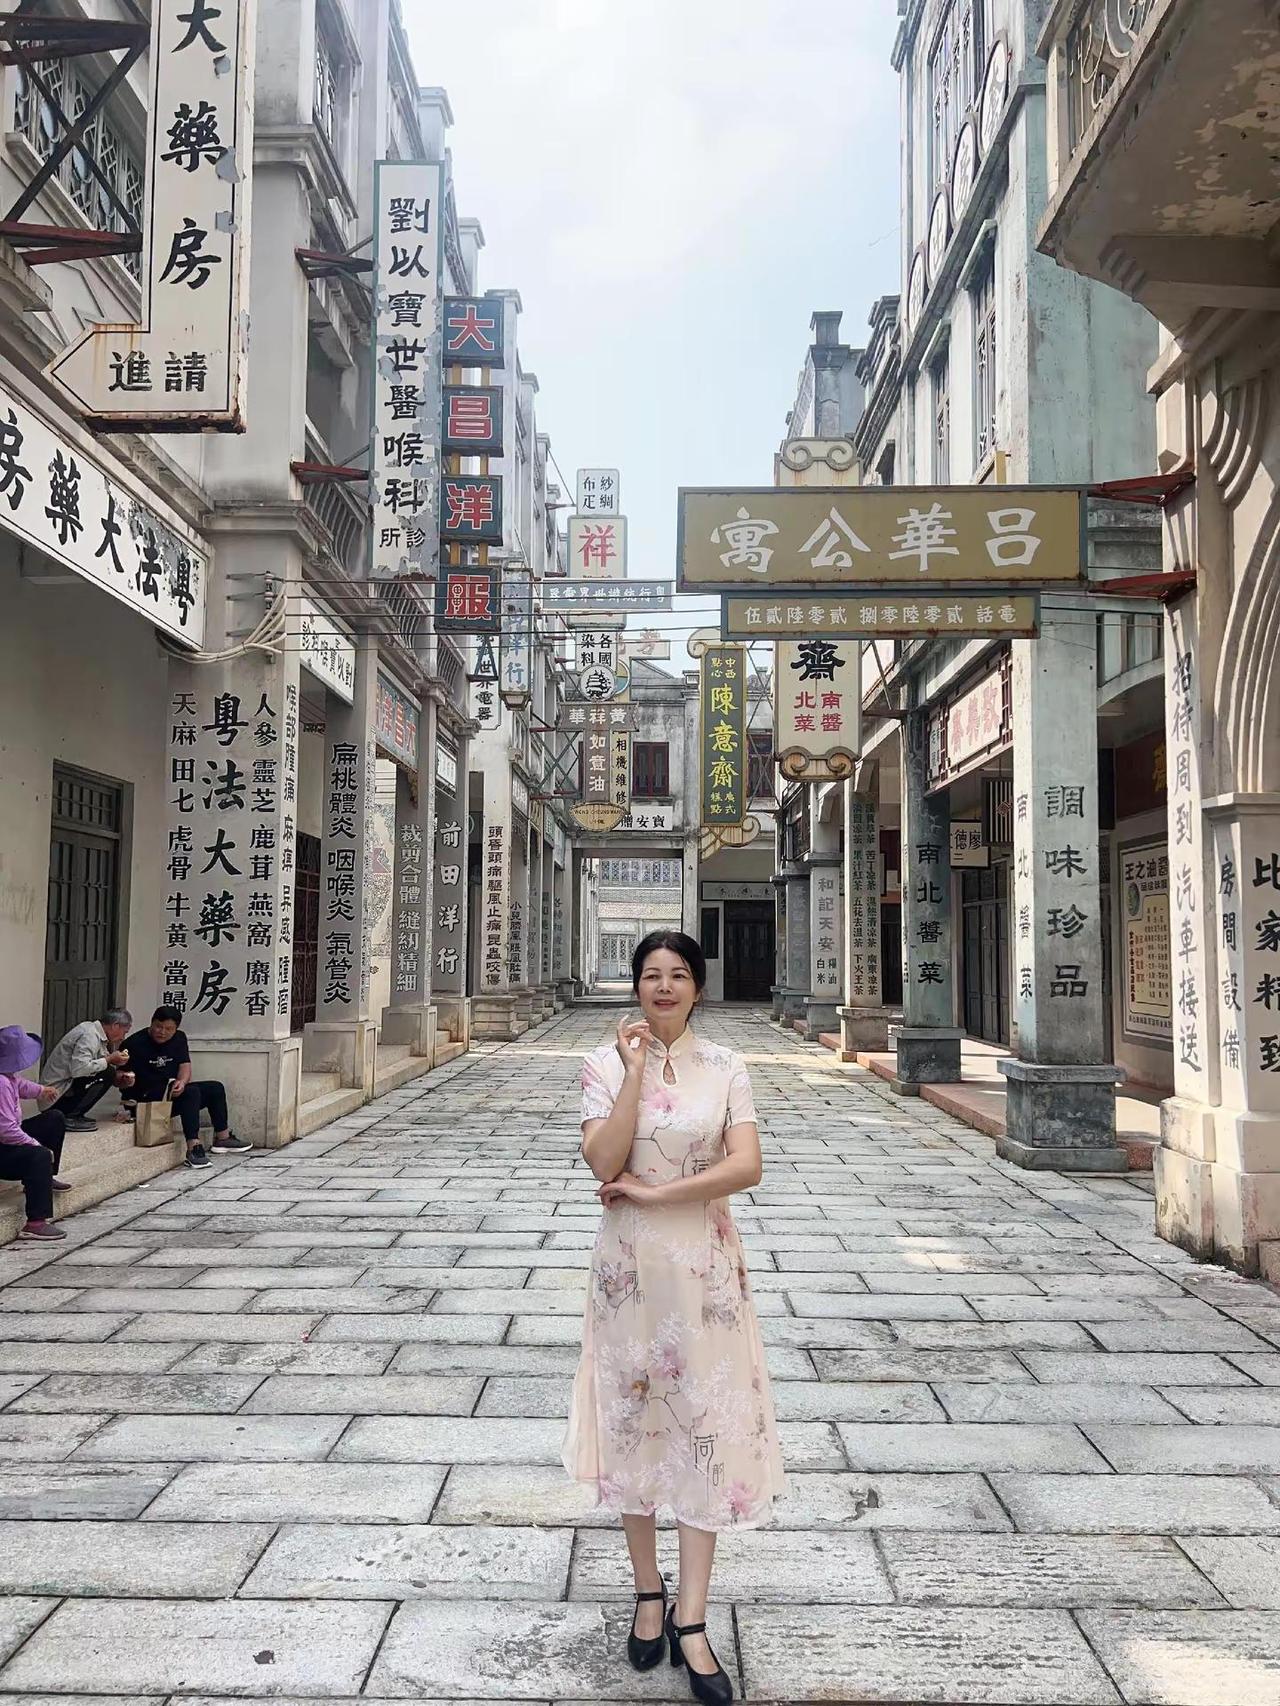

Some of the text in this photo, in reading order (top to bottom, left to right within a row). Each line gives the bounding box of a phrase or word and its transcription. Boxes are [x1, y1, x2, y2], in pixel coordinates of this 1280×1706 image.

[159, 0, 228, 290] 大藥房
[383, 197, 431, 515] 劉以寶世醫喉科
[444, 305, 496, 621] 大昌洋服
[577, 524, 618, 568] 祥
[581, 633, 596, 667] 染料
[599, 633, 613, 667] 各國
[171, 692, 198, 747] 天麻
[569, 708, 627, 725] 黃祥華
[708, 683, 739, 788] 陳意齋
[170, 757, 197, 813] 田七
[250, 757, 277, 814] 靈芝
[588, 733, 606, 792] 如意油
[167, 825, 193, 881] 虎骨
[190, 691, 250, 1017] 粵法大藥房
[248, 823, 276, 882] 鹿茸
[322, 742, 359, 1005] 扁桃體炎 咽喉炎 氣管炎
[246, 892, 274, 949] 燕窩
[436, 821, 463, 975] 前田洋行
[915, 842, 945, 985] 南北醬菜
[1044, 785, 1089, 998] 調味珍品
